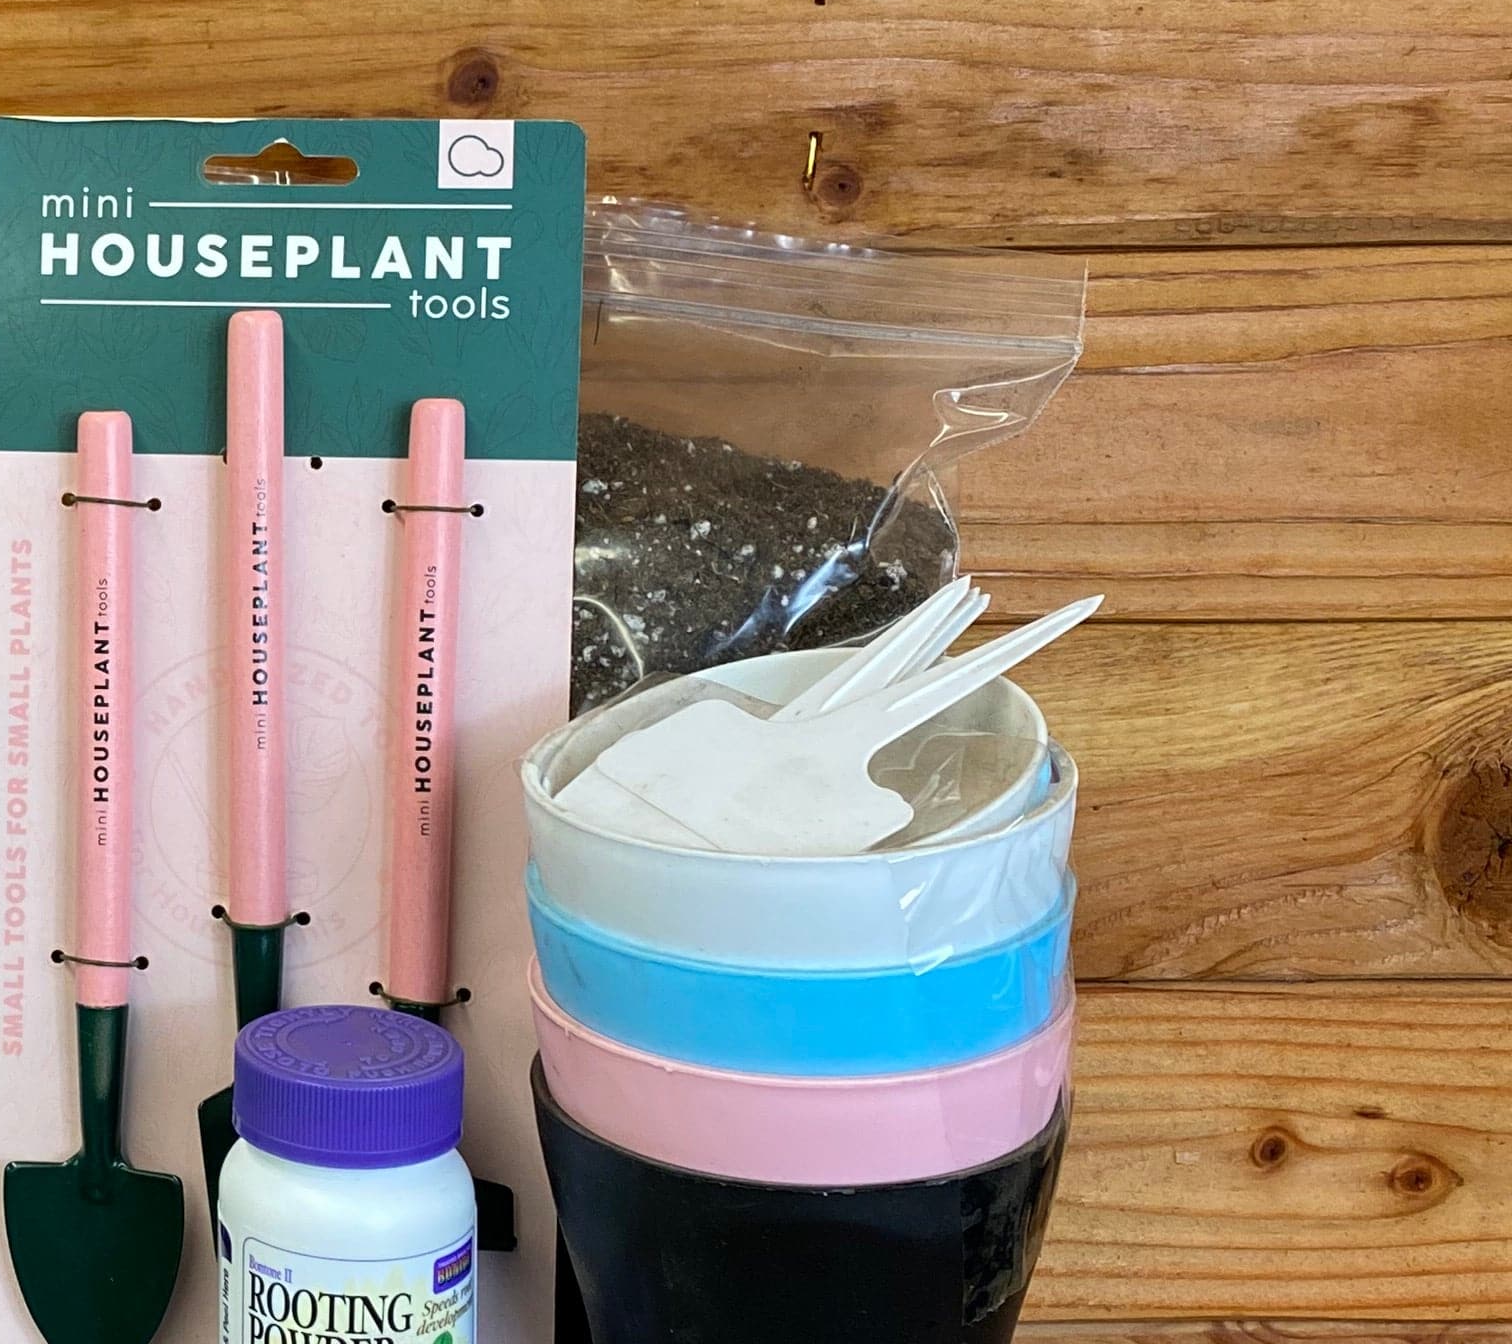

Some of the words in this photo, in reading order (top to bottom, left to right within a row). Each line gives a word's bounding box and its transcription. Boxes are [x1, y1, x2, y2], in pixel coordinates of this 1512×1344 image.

[41, 187, 134, 219] mini
[40, 231, 512, 280] HOUSEPLANT
[408, 286, 510, 320] tools
[256, 478, 267, 518] tools
[9, 538, 33, 656] PLANTS
[96, 577, 108, 617] tools
[425, 565, 438, 605] tools
[251, 521, 269, 706] HOUSEPLANT
[7, 666, 31, 767] SMALL
[93, 621, 110, 803] HOUSEPLANT
[414, 608, 436, 793] HOUSEPLANT
[256, 712, 267, 751] mini
[6, 777, 29, 836] FOR
[97, 809, 108, 846] mini
[420, 799, 431, 837] mini
[4, 846, 27, 947] TOOLS
[2, 956, 25, 1057] SMALL
[248, 1270, 413, 1335] ROOTING
[421, 1289, 459, 1319] Speeds
